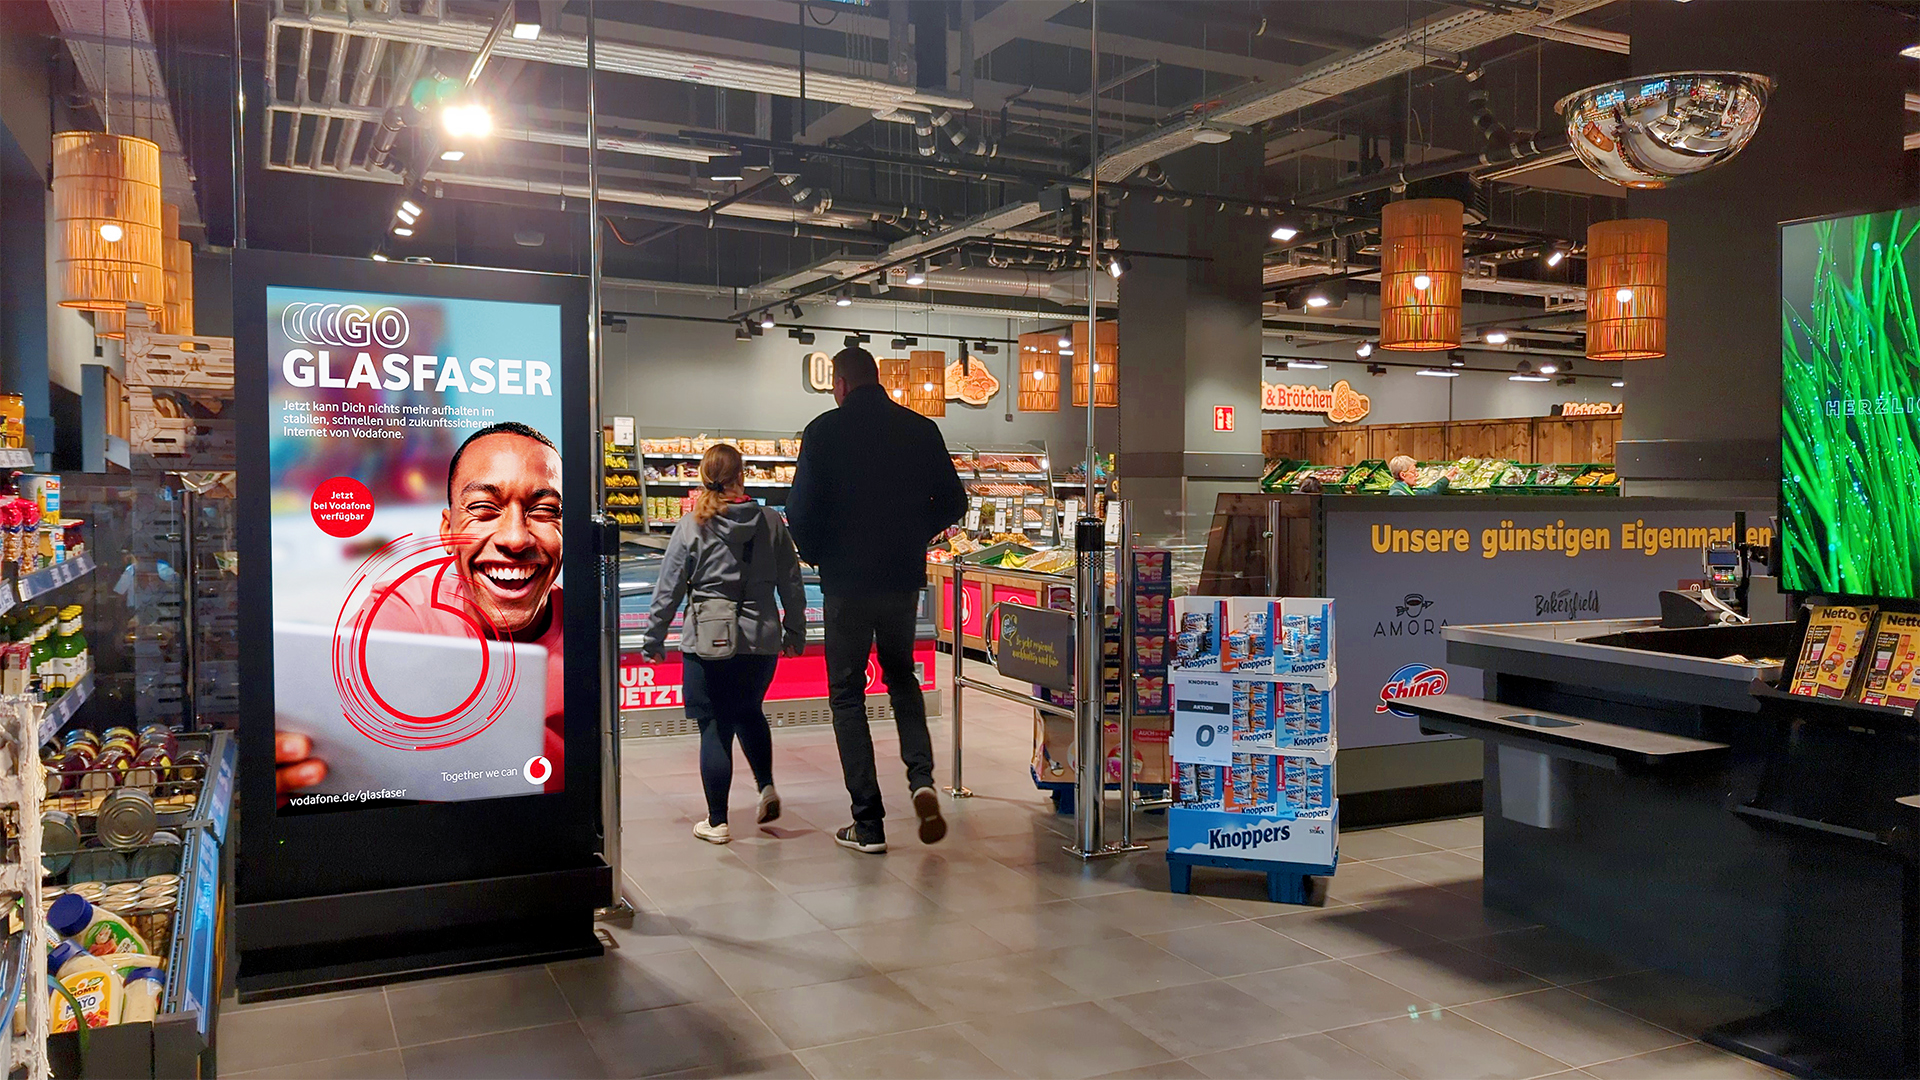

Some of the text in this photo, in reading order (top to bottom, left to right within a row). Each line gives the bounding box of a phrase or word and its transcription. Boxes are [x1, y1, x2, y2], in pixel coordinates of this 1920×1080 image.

[336, 304, 410, 349] GO
[282, 348, 553, 396] GLASFASER
[1266, 388, 1333, 408] & Brötchen
[283, 400, 494, 416] Jetzt kann Dich nichts mehr aufhalten im
[283, 414, 495, 429] stabilen, schnellen und zukunftssicheren
[283, 426, 404, 439] Internet von Vodafone.
[330, 491, 354, 499] Jetzt
[313, 502, 371, 510] bei Vodafone
[320, 512, 365, 522] verfügbar
[1371, 524, 1470, 553] Unsere
[1481, 519, 1610, 558] günstigen
[1534, 590, 1600, 619] Bakersfield
[1821, 608, 1857, 620] Netto
[1373, 618, 1450, 637] AMORA
[1185, 656, 1218, 669] Knoppers
[1238, 658, 1272, 670] Knoppers
[1291, 661, 1326, 673] Knoppers
[620, 667, 655, 687] UR
[620, 684, 683, 706] JETZT
[1376, 670, 1447, 713] Shine
[1195, 724, 1230, 747] 0 99
[1240, 731, 1273, 742] Knoppers
[1293, 735, 1328, 747] Knoppers
[441, 767, 518, 783] Together we can
[289, 788, 407, 807] vodafone.de/glasfaser
[1188, 801, 1221, 811] Knoppers
[1241, 804, 1275, 815] Knoppers
[1294, 808, 1329, 819] Knoppers
[1209, 825, 1291, 850] Knoppers
